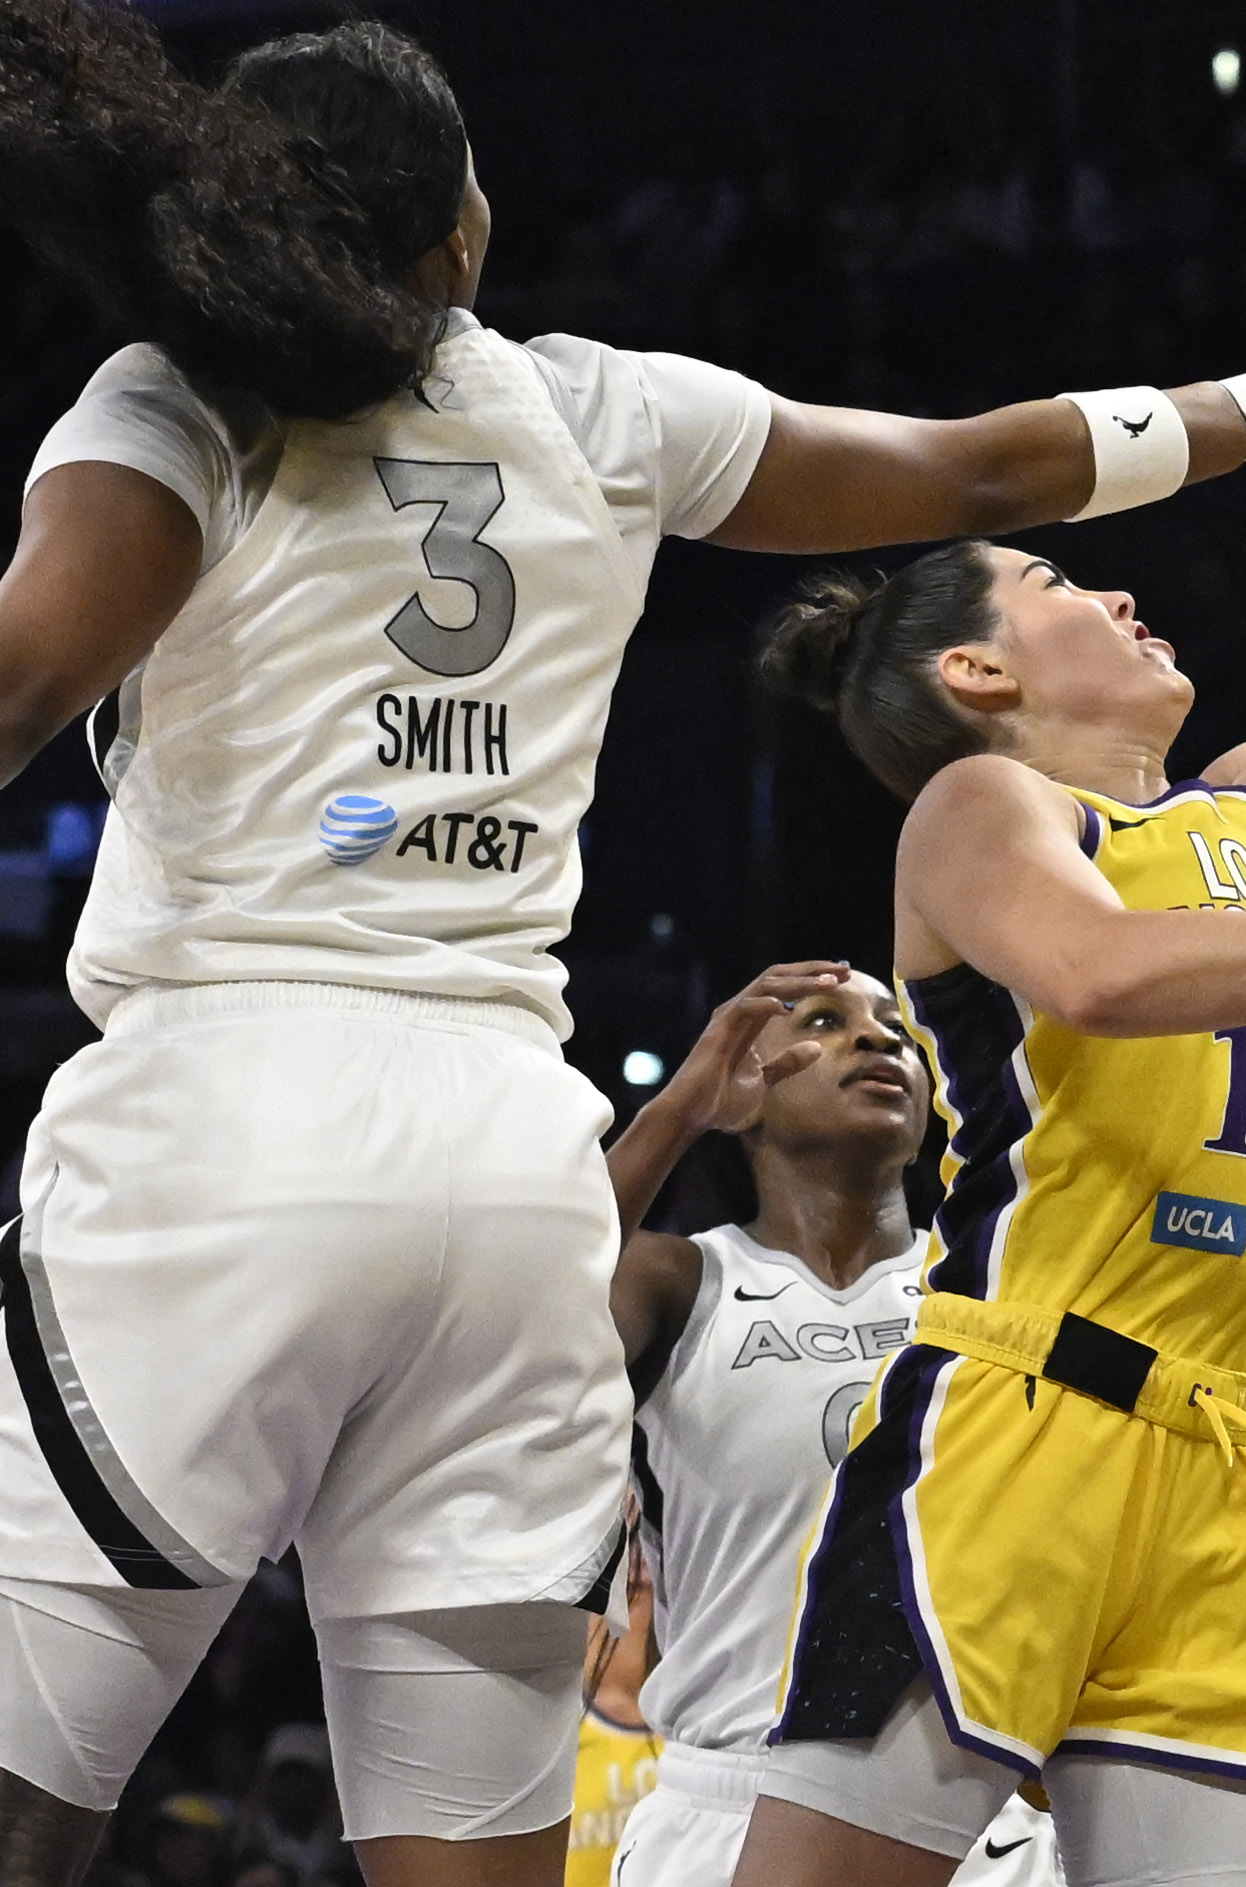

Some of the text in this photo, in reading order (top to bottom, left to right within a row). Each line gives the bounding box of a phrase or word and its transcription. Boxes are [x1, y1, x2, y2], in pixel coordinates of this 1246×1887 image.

[372, 456, 516, 678] 3
[376, 693, 510, 775] SMITH
[395, 812, 539, 873] AT&T
[1166, 1205, 1236, 1243] UCLA
[731, 1316, 918, 1370] ACE
